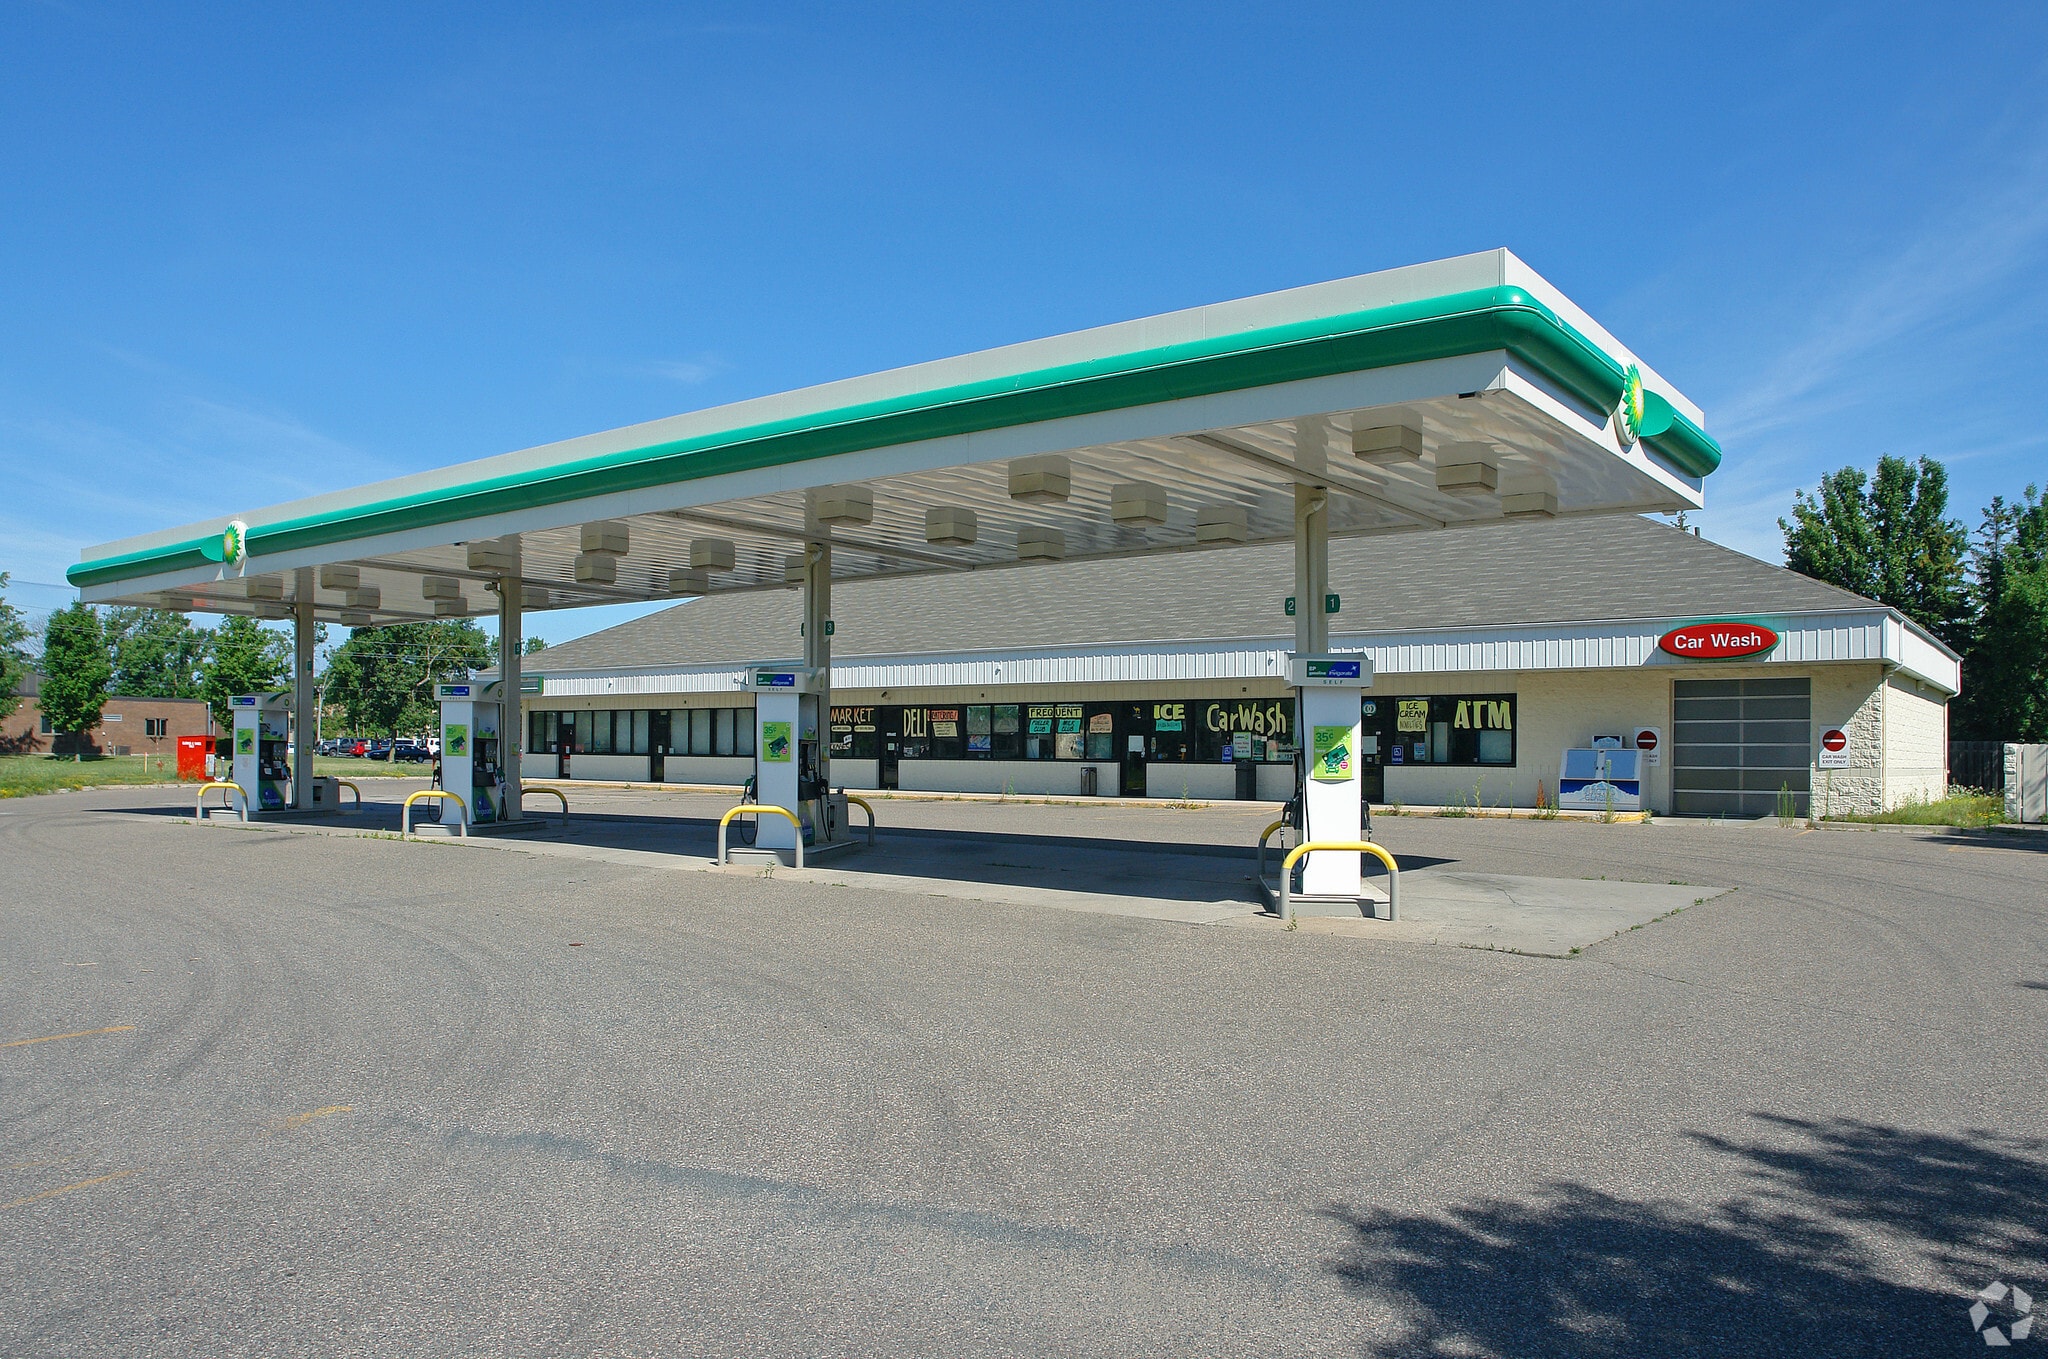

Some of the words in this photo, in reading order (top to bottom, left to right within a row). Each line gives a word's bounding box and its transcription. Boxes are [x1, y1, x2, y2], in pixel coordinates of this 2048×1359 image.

[1287, 600, 1295, 611] 2
[1330, 598, 1336, 608] 1
[827, 623, 832, 632] 3
[1674, 634, 1704, 649] Car
[1710, 631, 1762, 648] Wash
[1153, 703, 1186, 720] ICE
[1405, 702, 1419, 710] ICE
[830, 707, 875, 724] MARKET
[1030, 708, 1081, 717] FREQUENT
[1399, 710, 1426, 718] CREAM
[1453, 699, 1513, 731] ATM
[903, 708, 928, 738] DELI
